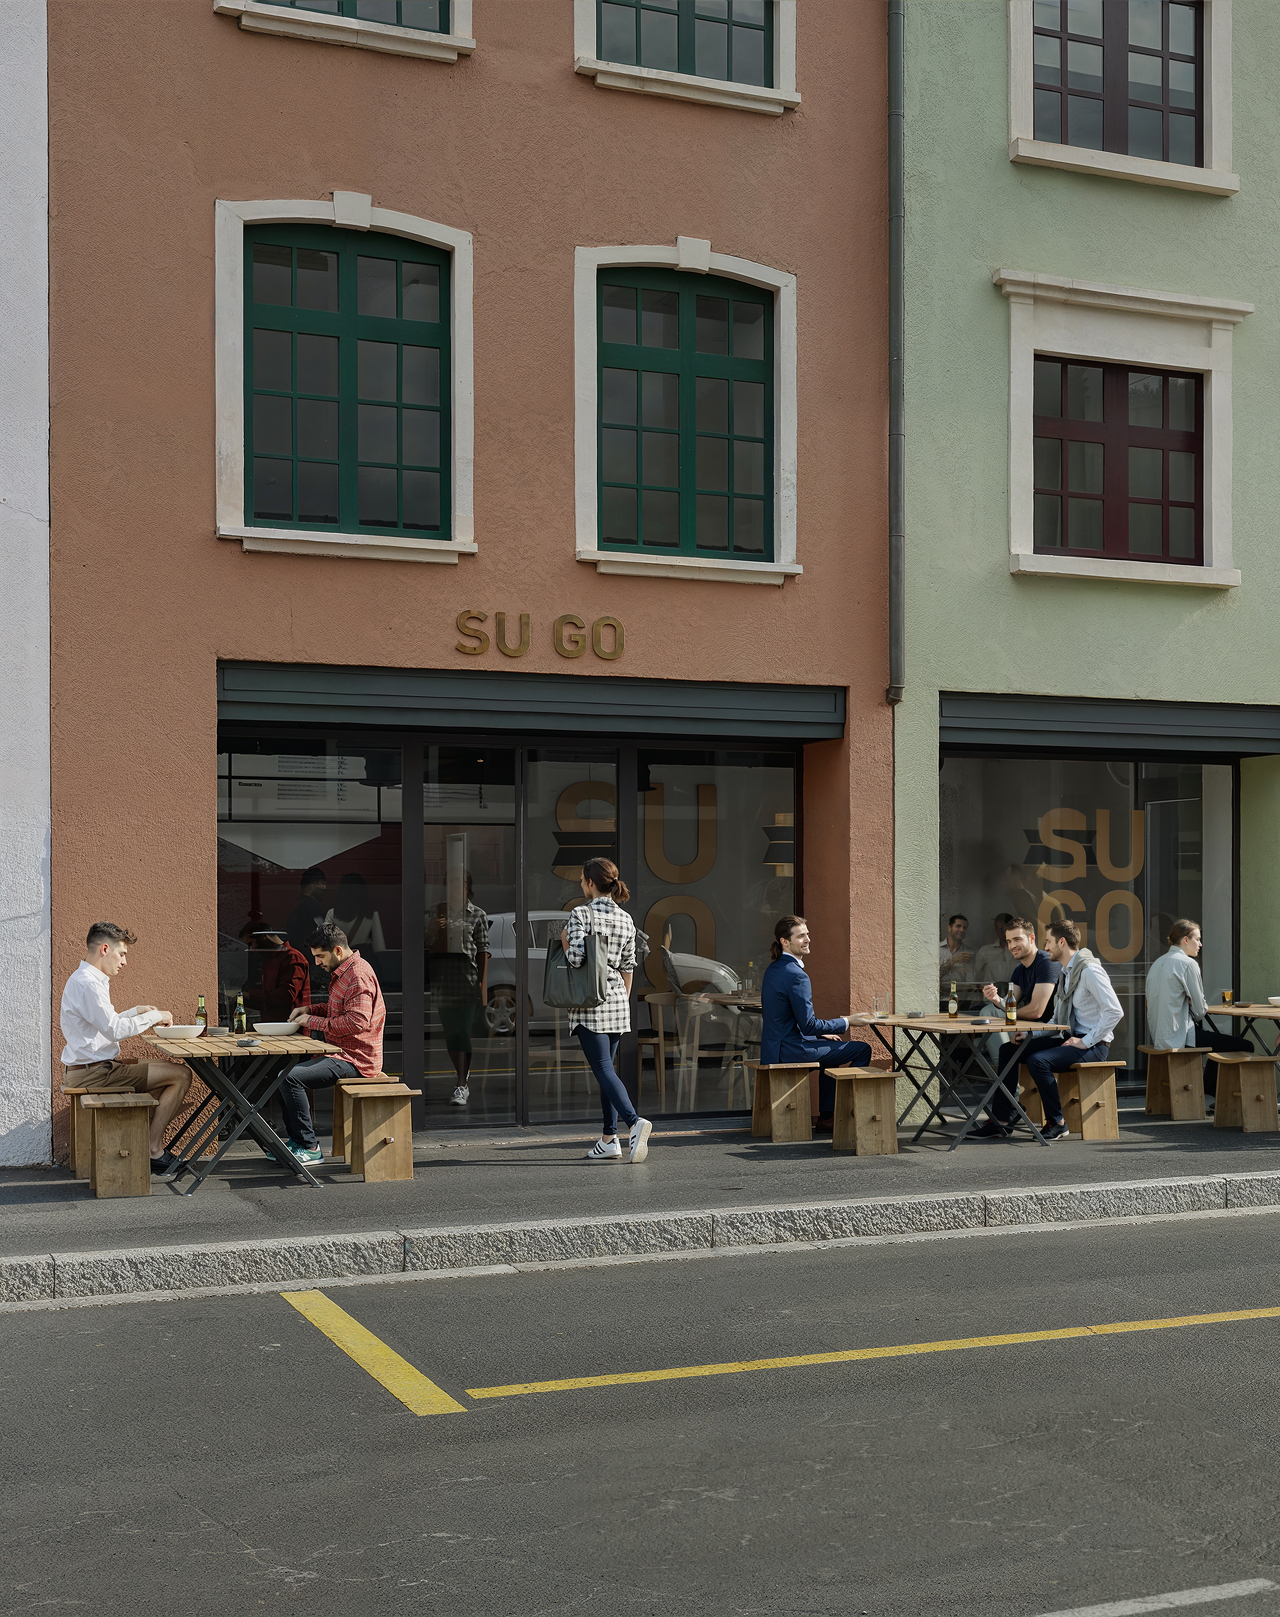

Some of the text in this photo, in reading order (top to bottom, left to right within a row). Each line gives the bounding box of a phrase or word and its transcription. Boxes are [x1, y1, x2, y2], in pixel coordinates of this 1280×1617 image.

[455, 609, 626, 661] SU GO
[1036, 807, 1146, 883] SU
